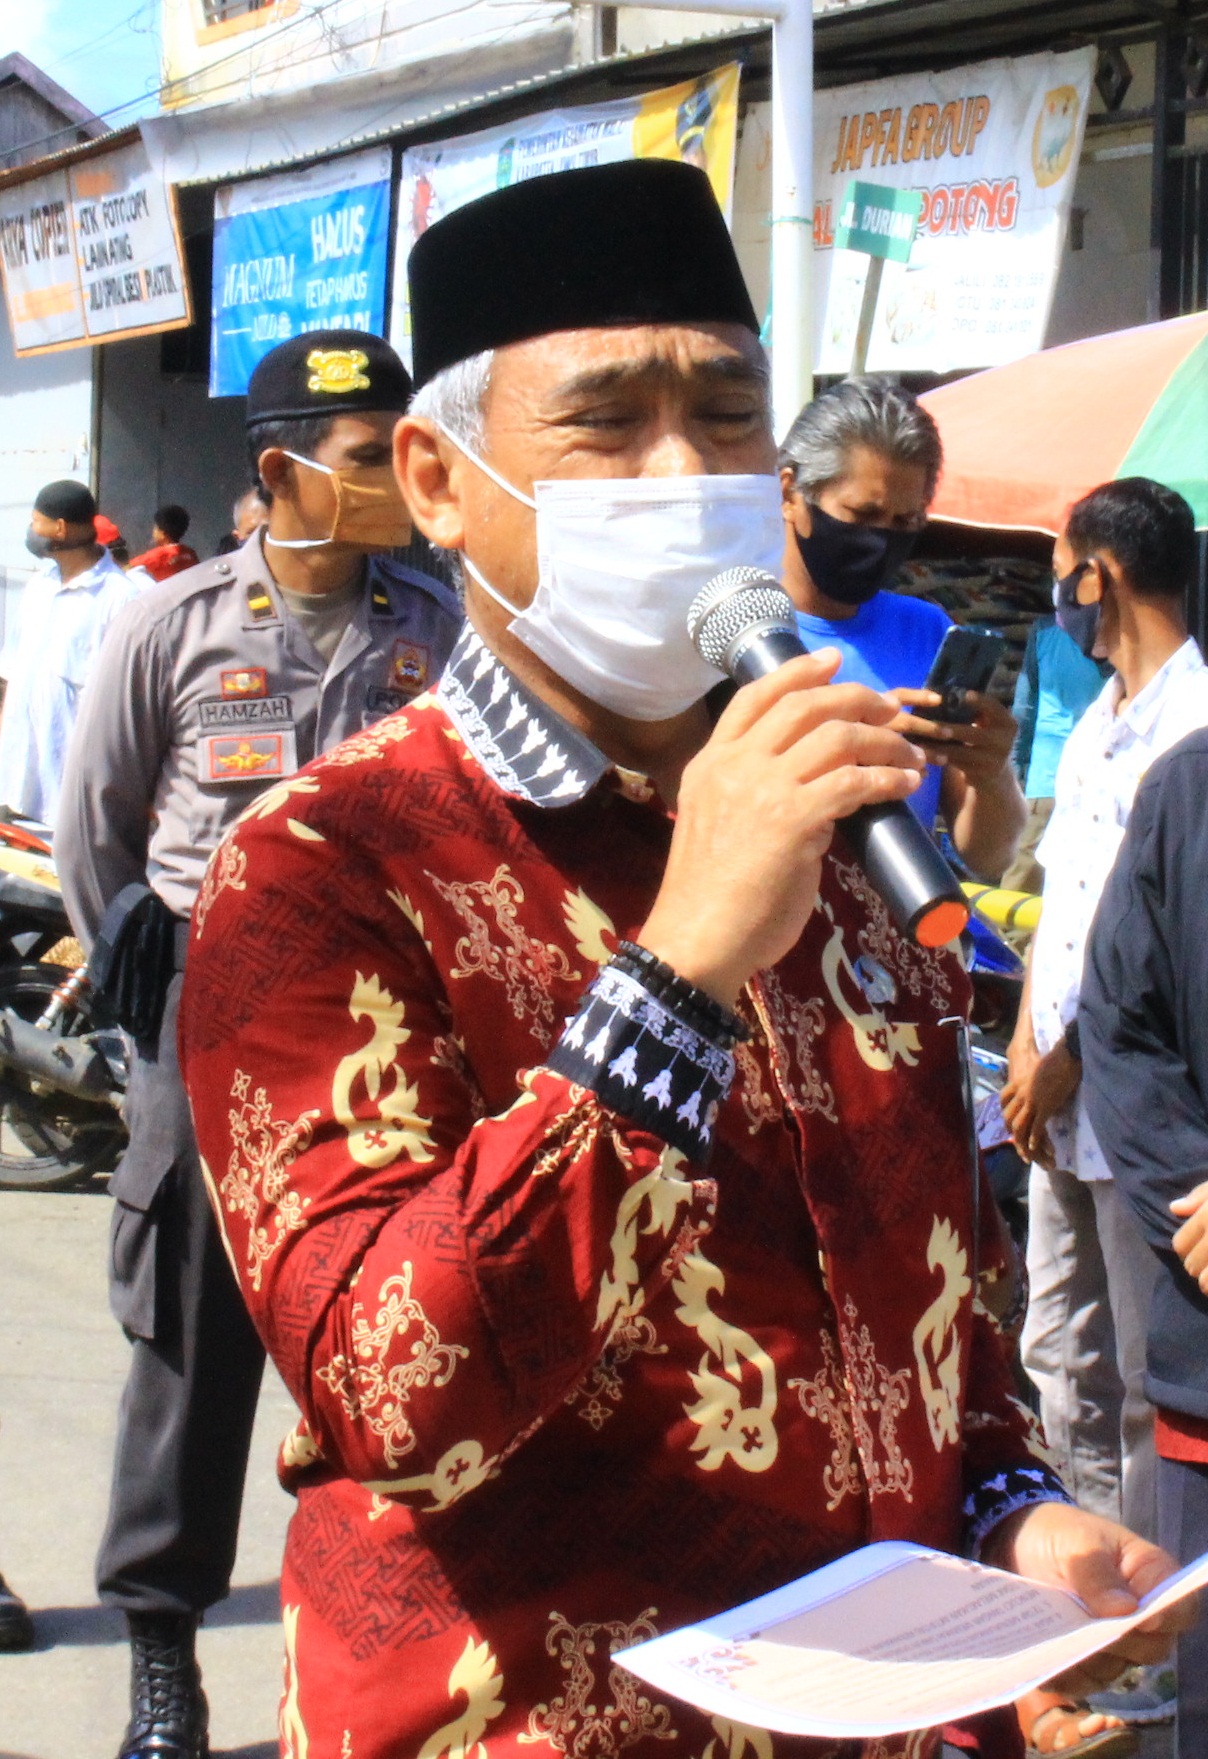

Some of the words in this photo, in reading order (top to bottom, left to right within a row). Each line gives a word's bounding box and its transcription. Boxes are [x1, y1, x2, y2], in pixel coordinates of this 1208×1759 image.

[831, 105, 902, 174] JAPFA
[902, 95, 990, 162] GROUP
[311, 205, 365, 263] HALUS
[861, 205, 915, 241] DURIAN
[222, 253, 296, 308] MAGNUM
[204, 699, 286, 723] HAMZAH
